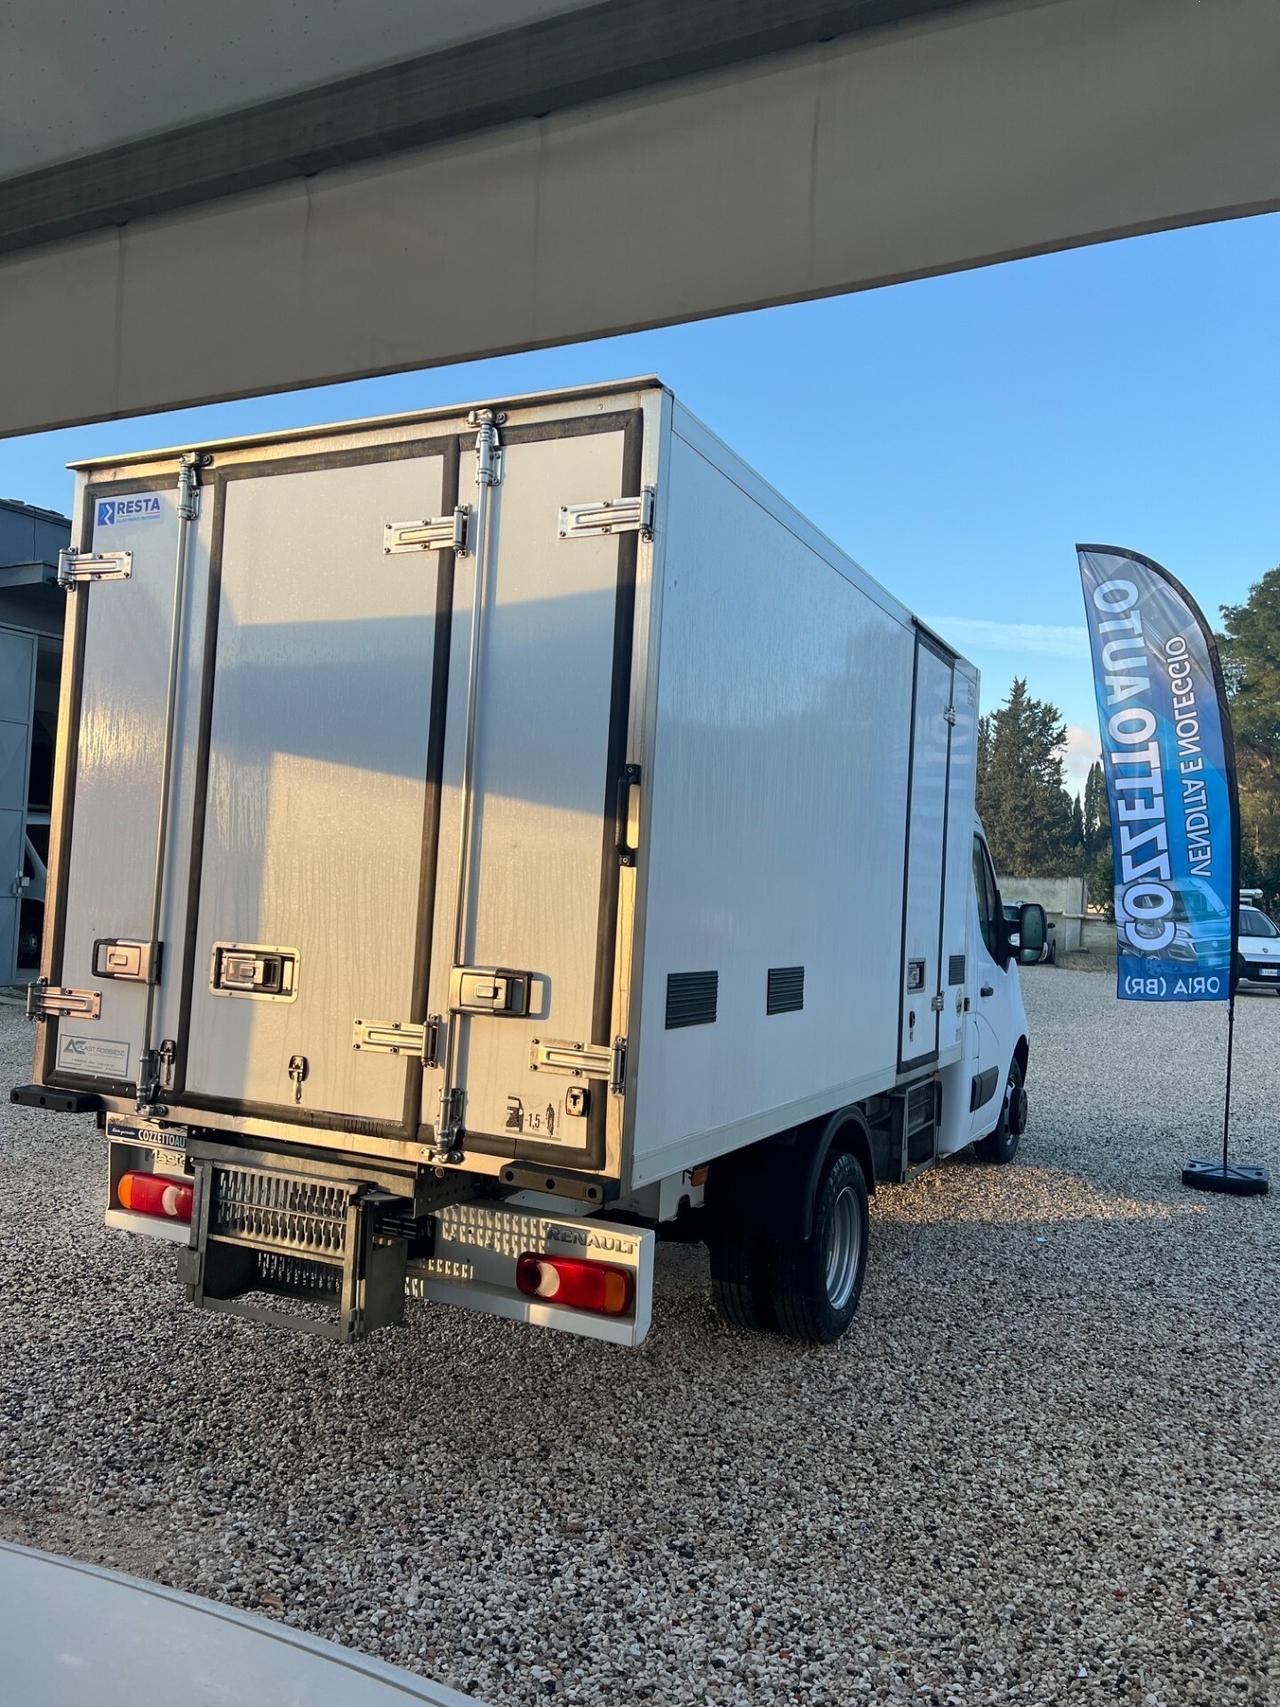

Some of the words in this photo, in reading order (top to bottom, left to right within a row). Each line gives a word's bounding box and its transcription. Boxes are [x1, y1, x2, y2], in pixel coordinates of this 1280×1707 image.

[117, 498, 160, 515] RESTA
[138, 1129, 187, 1149] COZZETTOAU
[546, 1226, 638, 1255] RENAULT
